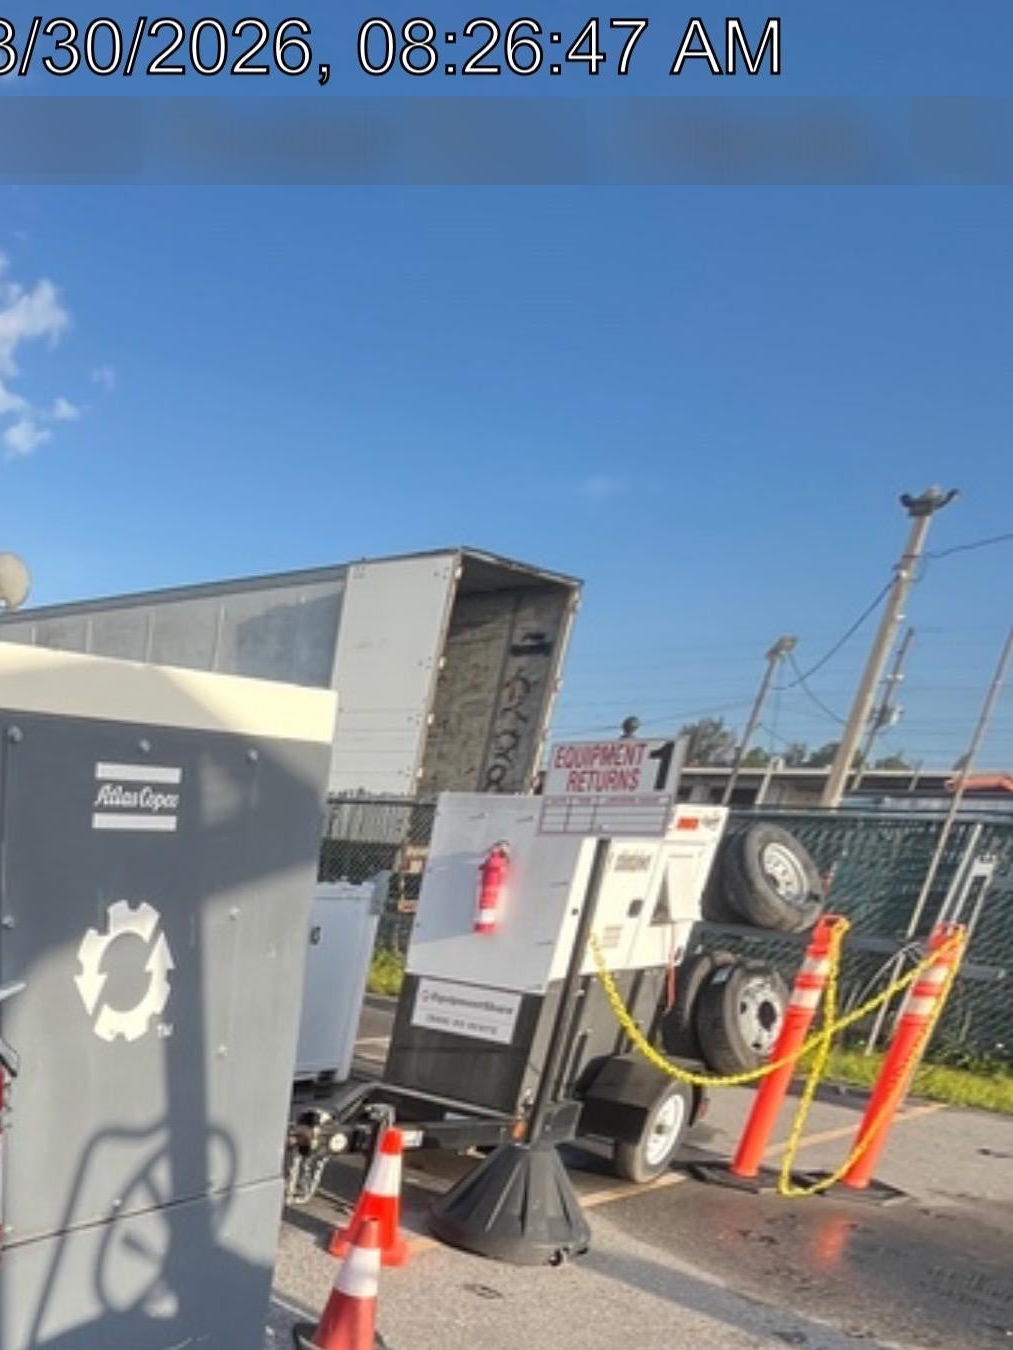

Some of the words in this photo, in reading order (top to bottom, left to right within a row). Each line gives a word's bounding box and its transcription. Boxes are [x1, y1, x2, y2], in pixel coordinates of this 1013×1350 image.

[554, 744, 647, 768] EQUIPMENT
[649, 741, 675, 790] 1
[566, 768, 641, 792] RETURNS
[94, 784, 139, 808] Atlas
[139, 785, 179, 812] Copco
